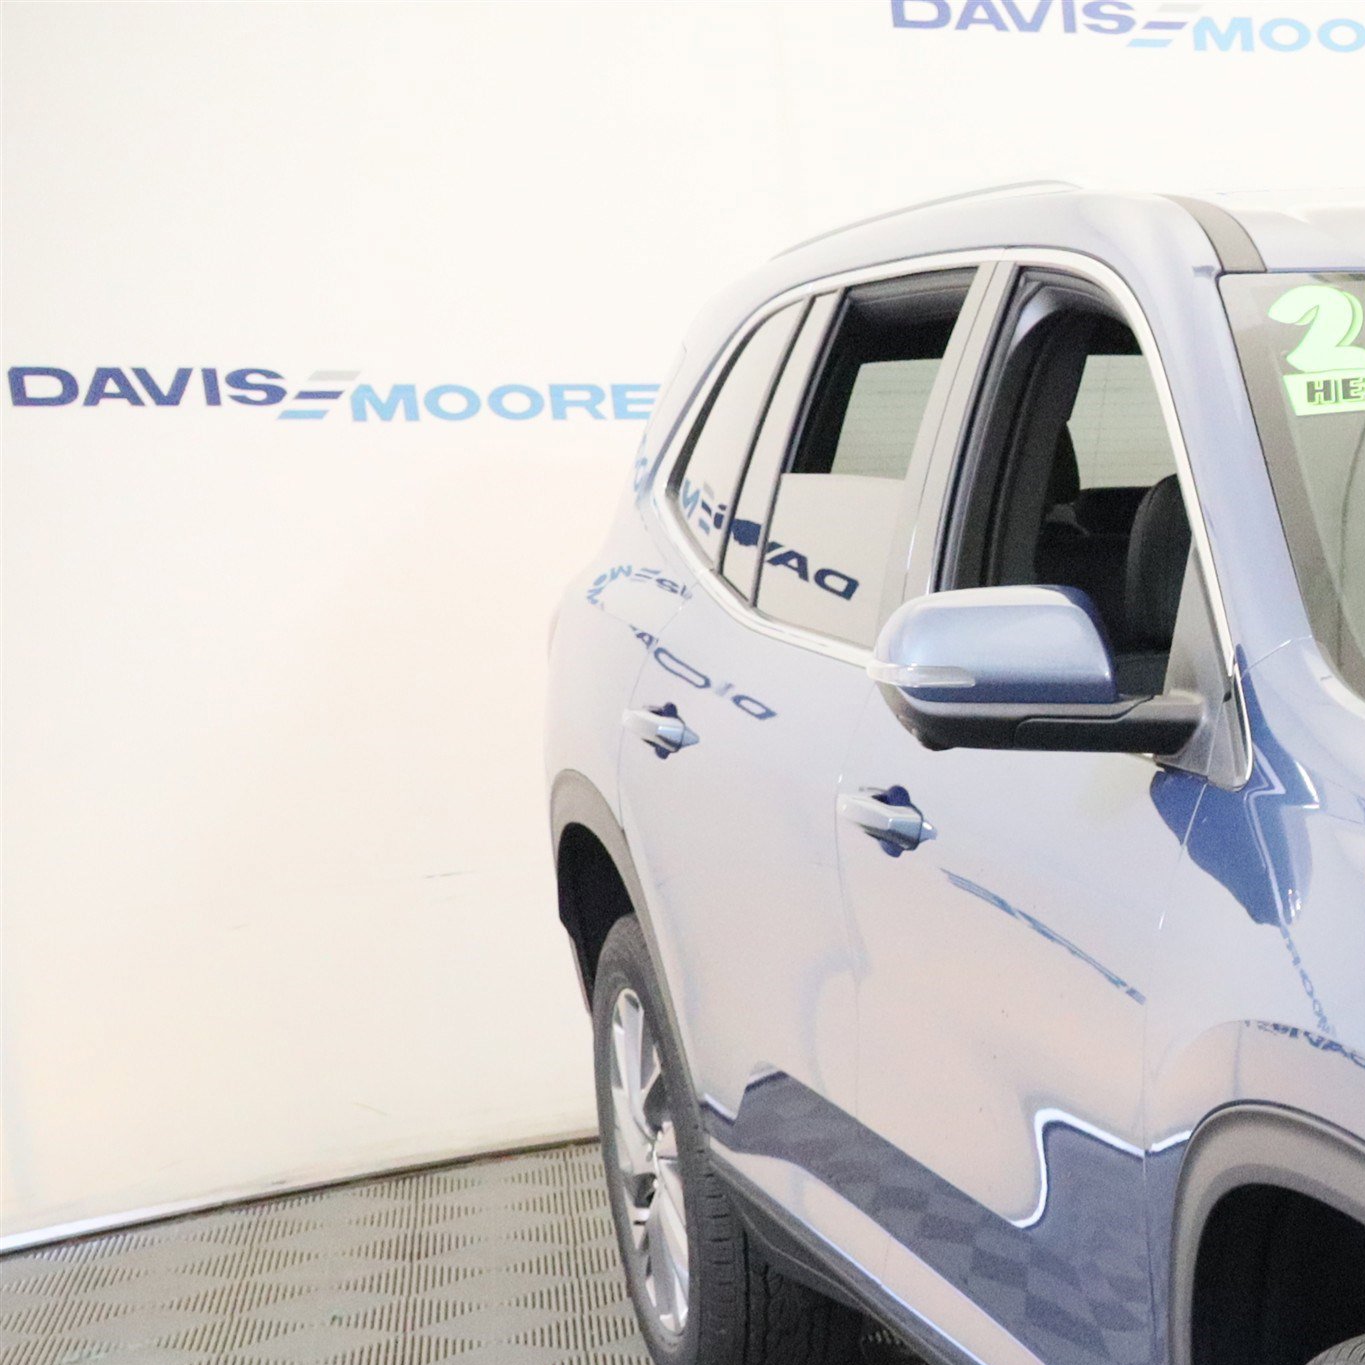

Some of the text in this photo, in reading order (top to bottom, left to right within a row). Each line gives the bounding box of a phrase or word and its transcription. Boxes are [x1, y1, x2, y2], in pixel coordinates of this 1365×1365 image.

[891, 0, 1138, 34] DAVIS
[6, 366, 662, 422] DAVIS MOORE
